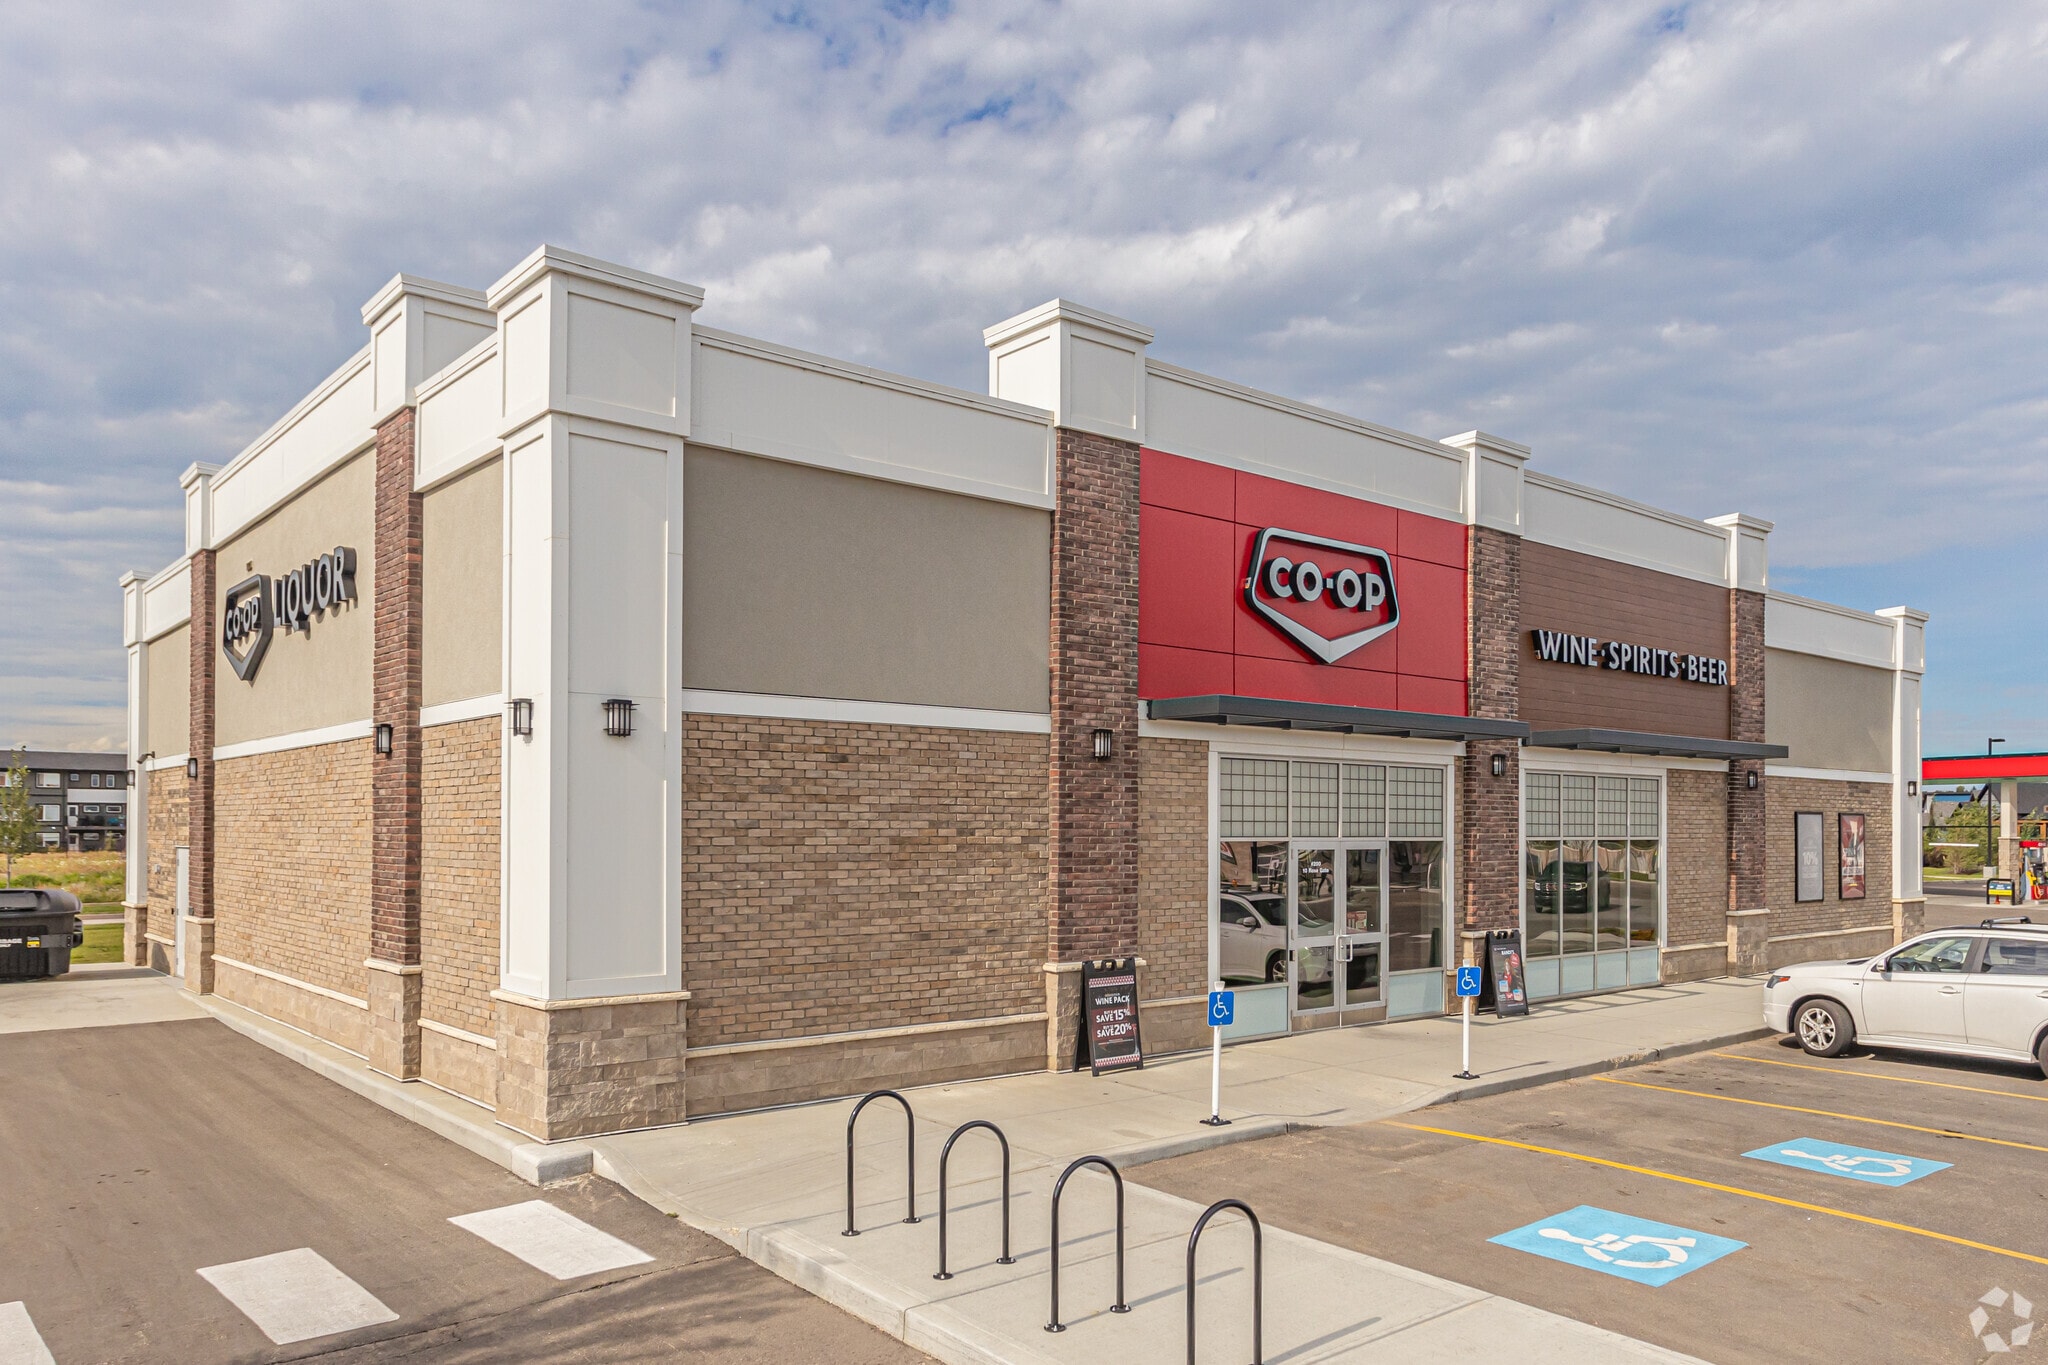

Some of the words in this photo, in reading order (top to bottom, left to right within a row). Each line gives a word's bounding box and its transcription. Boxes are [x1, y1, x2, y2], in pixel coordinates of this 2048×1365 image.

[273, 545, 352, 633] LIQUOR
[1264, 556, 1386, 612] CO-OP
[1538, 629, 1598, 667] WINE
[1608, 641, 1680, 679] SPIRITS
[1687, 654, 1728, 686] BEER
[1095, 997, 1113, 1006] WINE
[1113, 995, 1130, 1003] PACK
[1096, 1013, 1114, 1023] SAVE
[1114, 1009, 1131, 1021] 15%
[1097, 1029, 1114, 1038] SAVE
[1114, 1023, 1132, 1035] 20%
